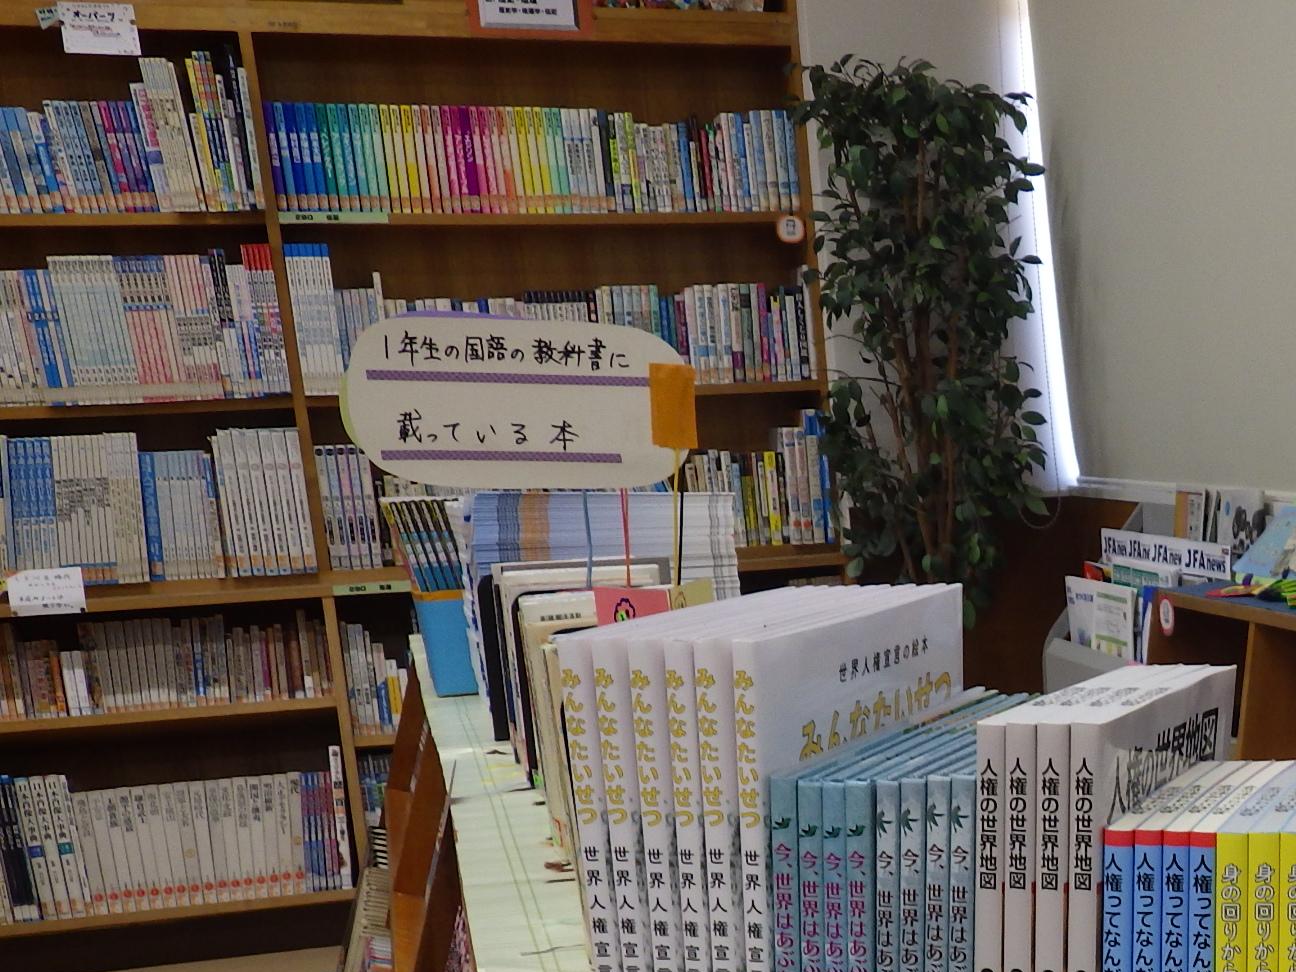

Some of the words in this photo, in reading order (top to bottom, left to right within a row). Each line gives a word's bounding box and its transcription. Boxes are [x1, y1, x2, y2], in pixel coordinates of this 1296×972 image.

[1152, 544, 1168, 564] JFA
[1185, 549, 1205, 570] JFA
[1206, 558, 1226, 573] news
[839, 635, 928, 683] 世界人権宣言の絵本
[562, 668, 597, 825] みんなたいせつ
[595, 668, 627, 825] みんなたいせつ
[631, 669, 662, 827] みんなたいせつ
[665, 669, 694, 827] みんなたいせつ
[695, 668, 724, 827] みんなたいせつ
[734, 670, 760, 828] みんなたいせつ
[980, 758, 998, 890] 人権の世界地図
[1009, 757, 1027, 890] 人権の世界地図
[1041, 757, 1060, 890] 人権の世界地図
[1074, 757, 1094, 890] 人権の世界地図
